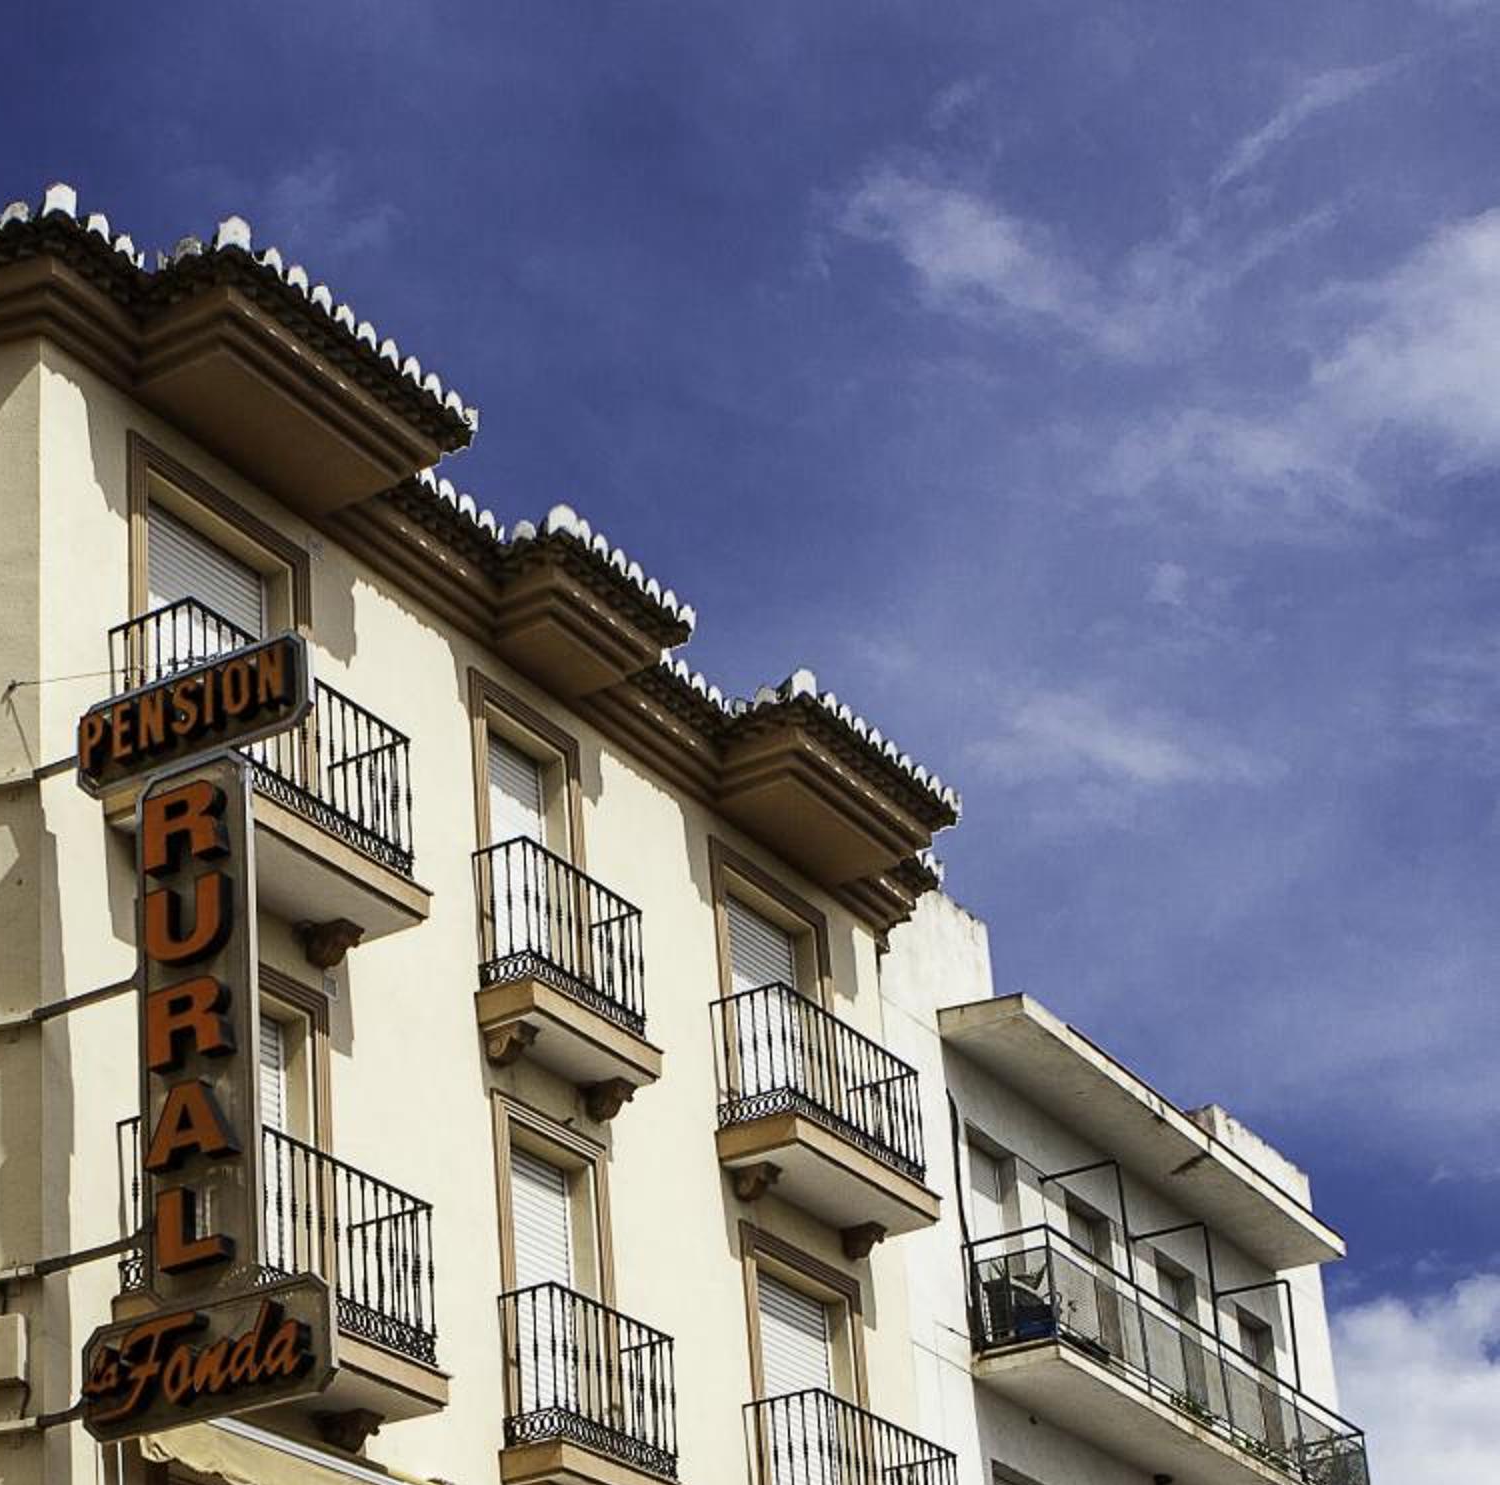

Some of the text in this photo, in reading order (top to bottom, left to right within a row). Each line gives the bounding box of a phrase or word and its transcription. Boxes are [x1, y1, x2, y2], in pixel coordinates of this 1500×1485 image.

[80, 646, 288, 771] PENSION
[143, 779, 233, 1273] RURAL
[91, 1297, 306, 1423] Fonda
